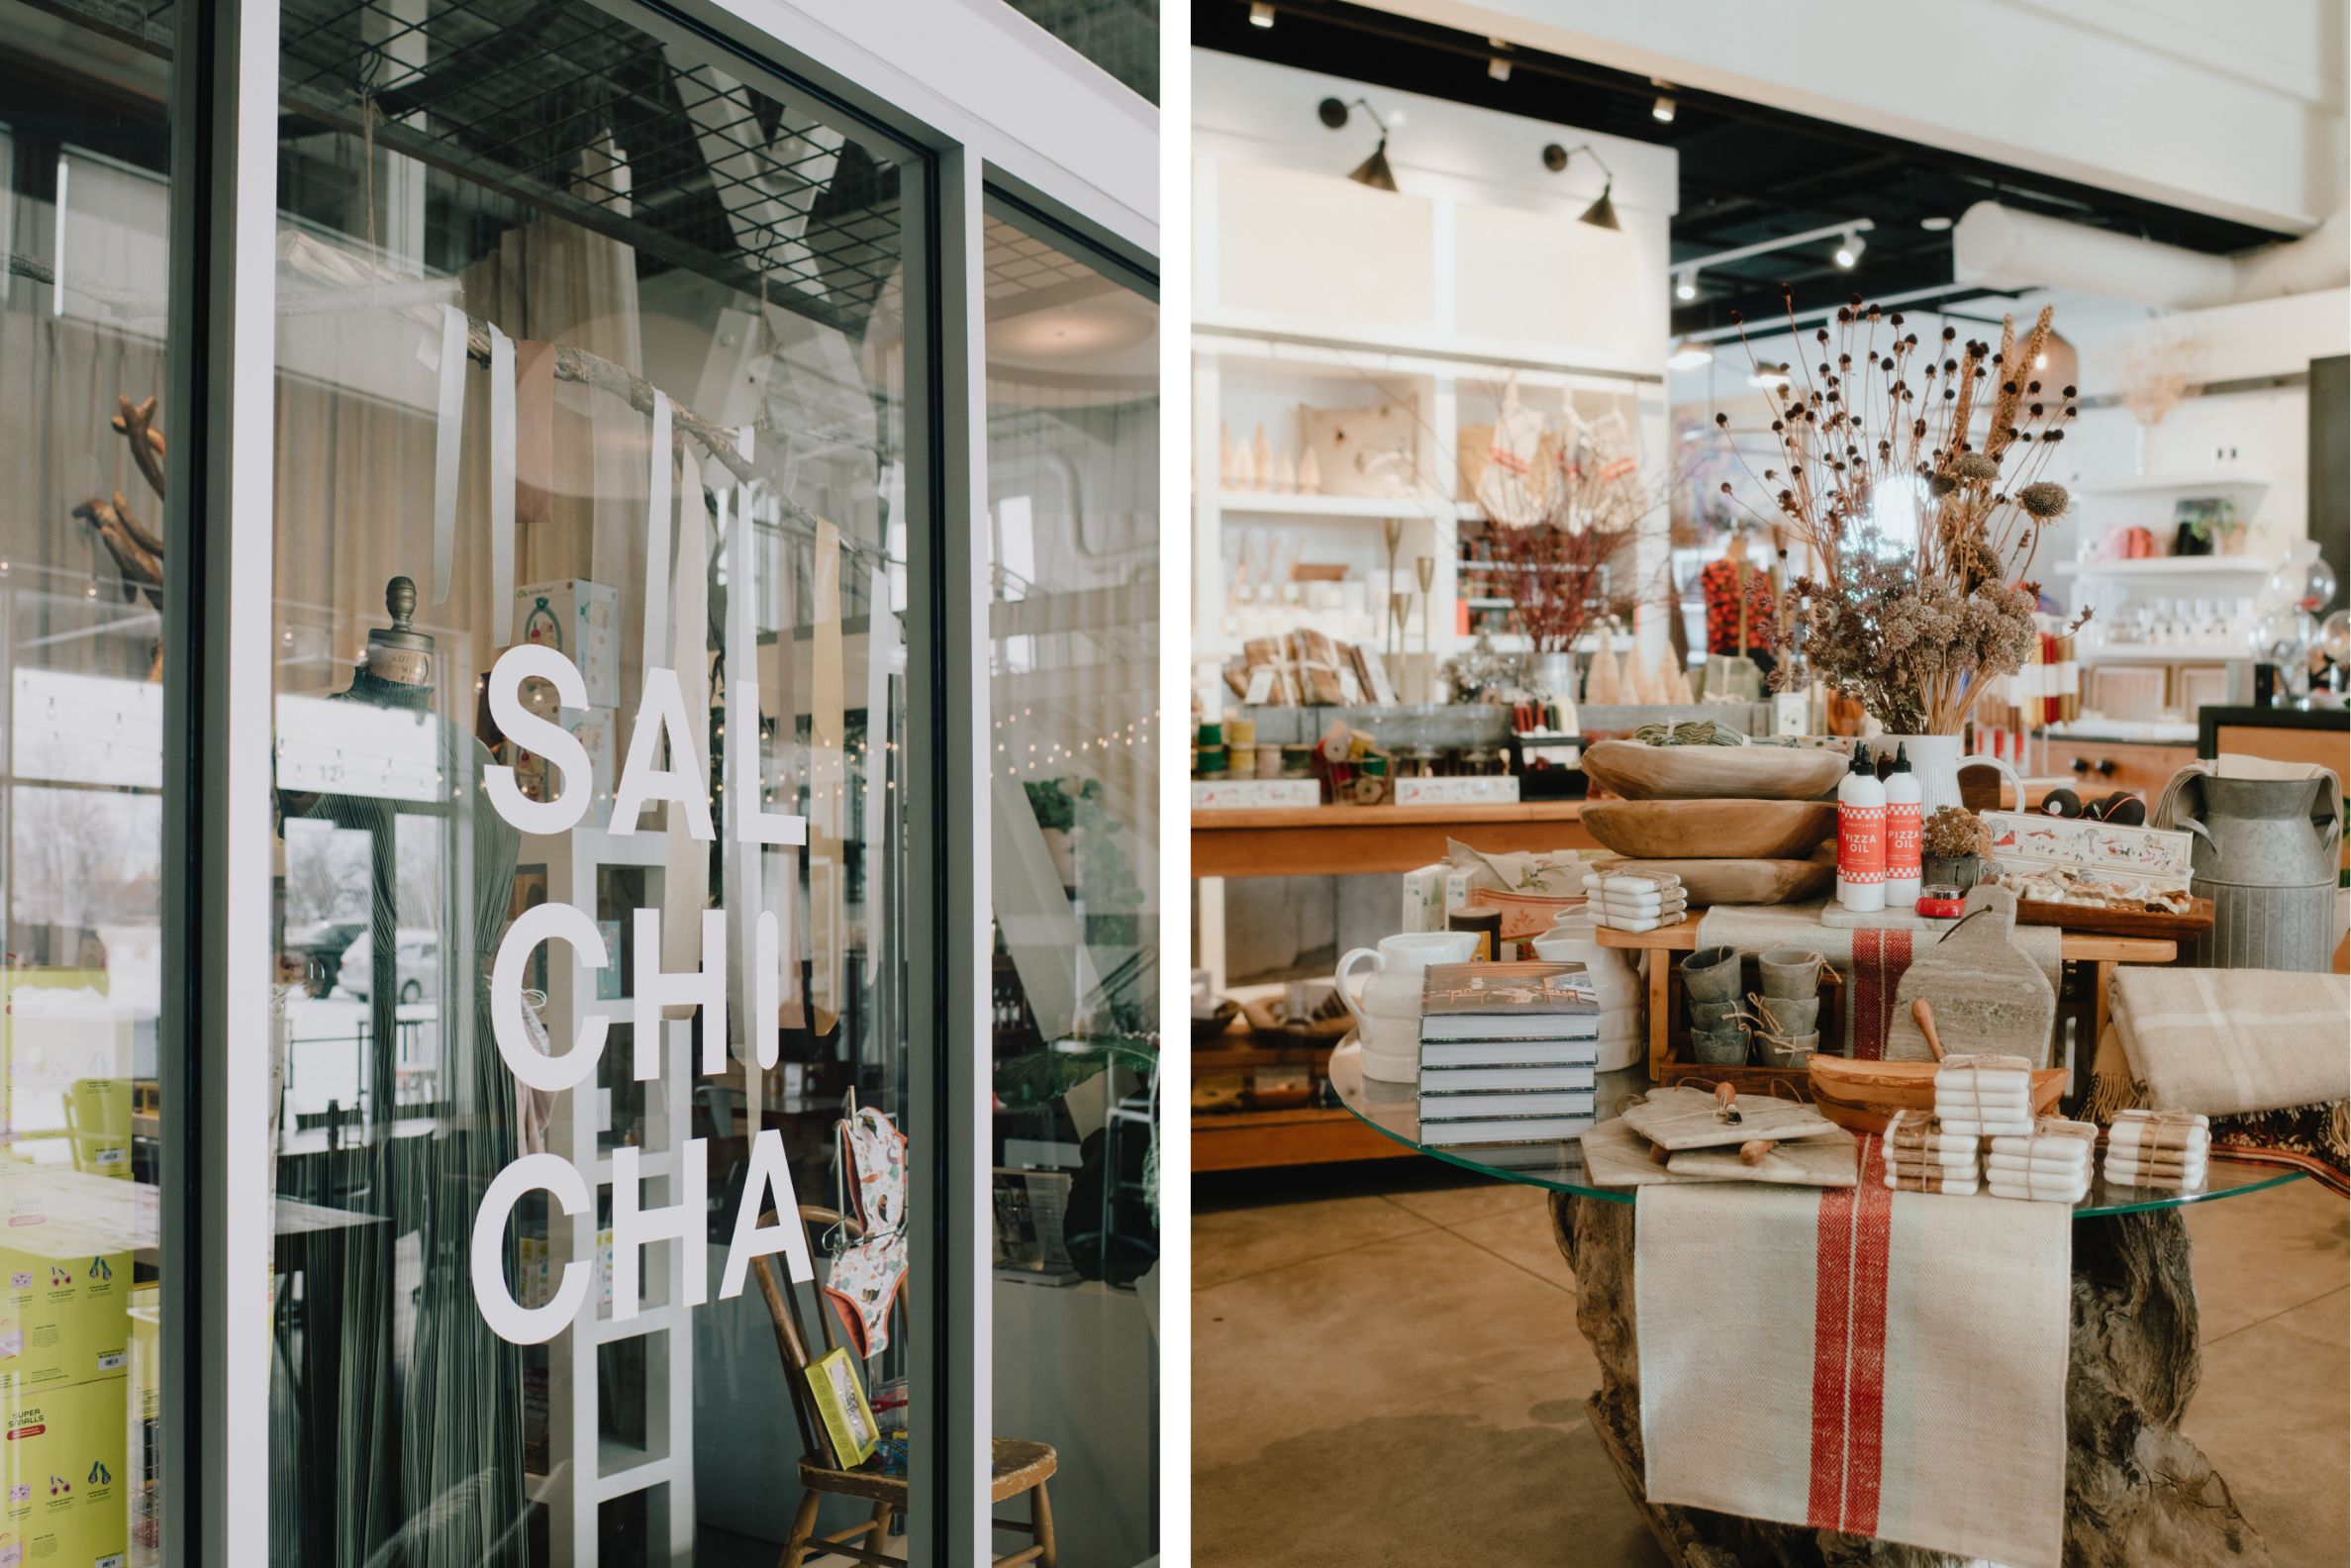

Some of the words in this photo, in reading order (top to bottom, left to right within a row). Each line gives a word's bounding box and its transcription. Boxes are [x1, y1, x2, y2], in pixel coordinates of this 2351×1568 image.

[484, 643, 807, 846] SAL
[1845, 833, 1877, 843] PIZZA
[1888, 831, 1919, 839] PIZZA
[1849, 843, 1869, 853] OIL
[1895, 839, 1914, 848] OIL
[491, 902, 779, 1092] CHI
[13, 1198, 42, 1207] SUPER
[9, 1205, 46, 1215] SMALLS
[471, 1128, 814, 1345] CHA
[12, 1409, 41, 1420] SUPER
[8, 1415, 45, 1427] SMALLS
